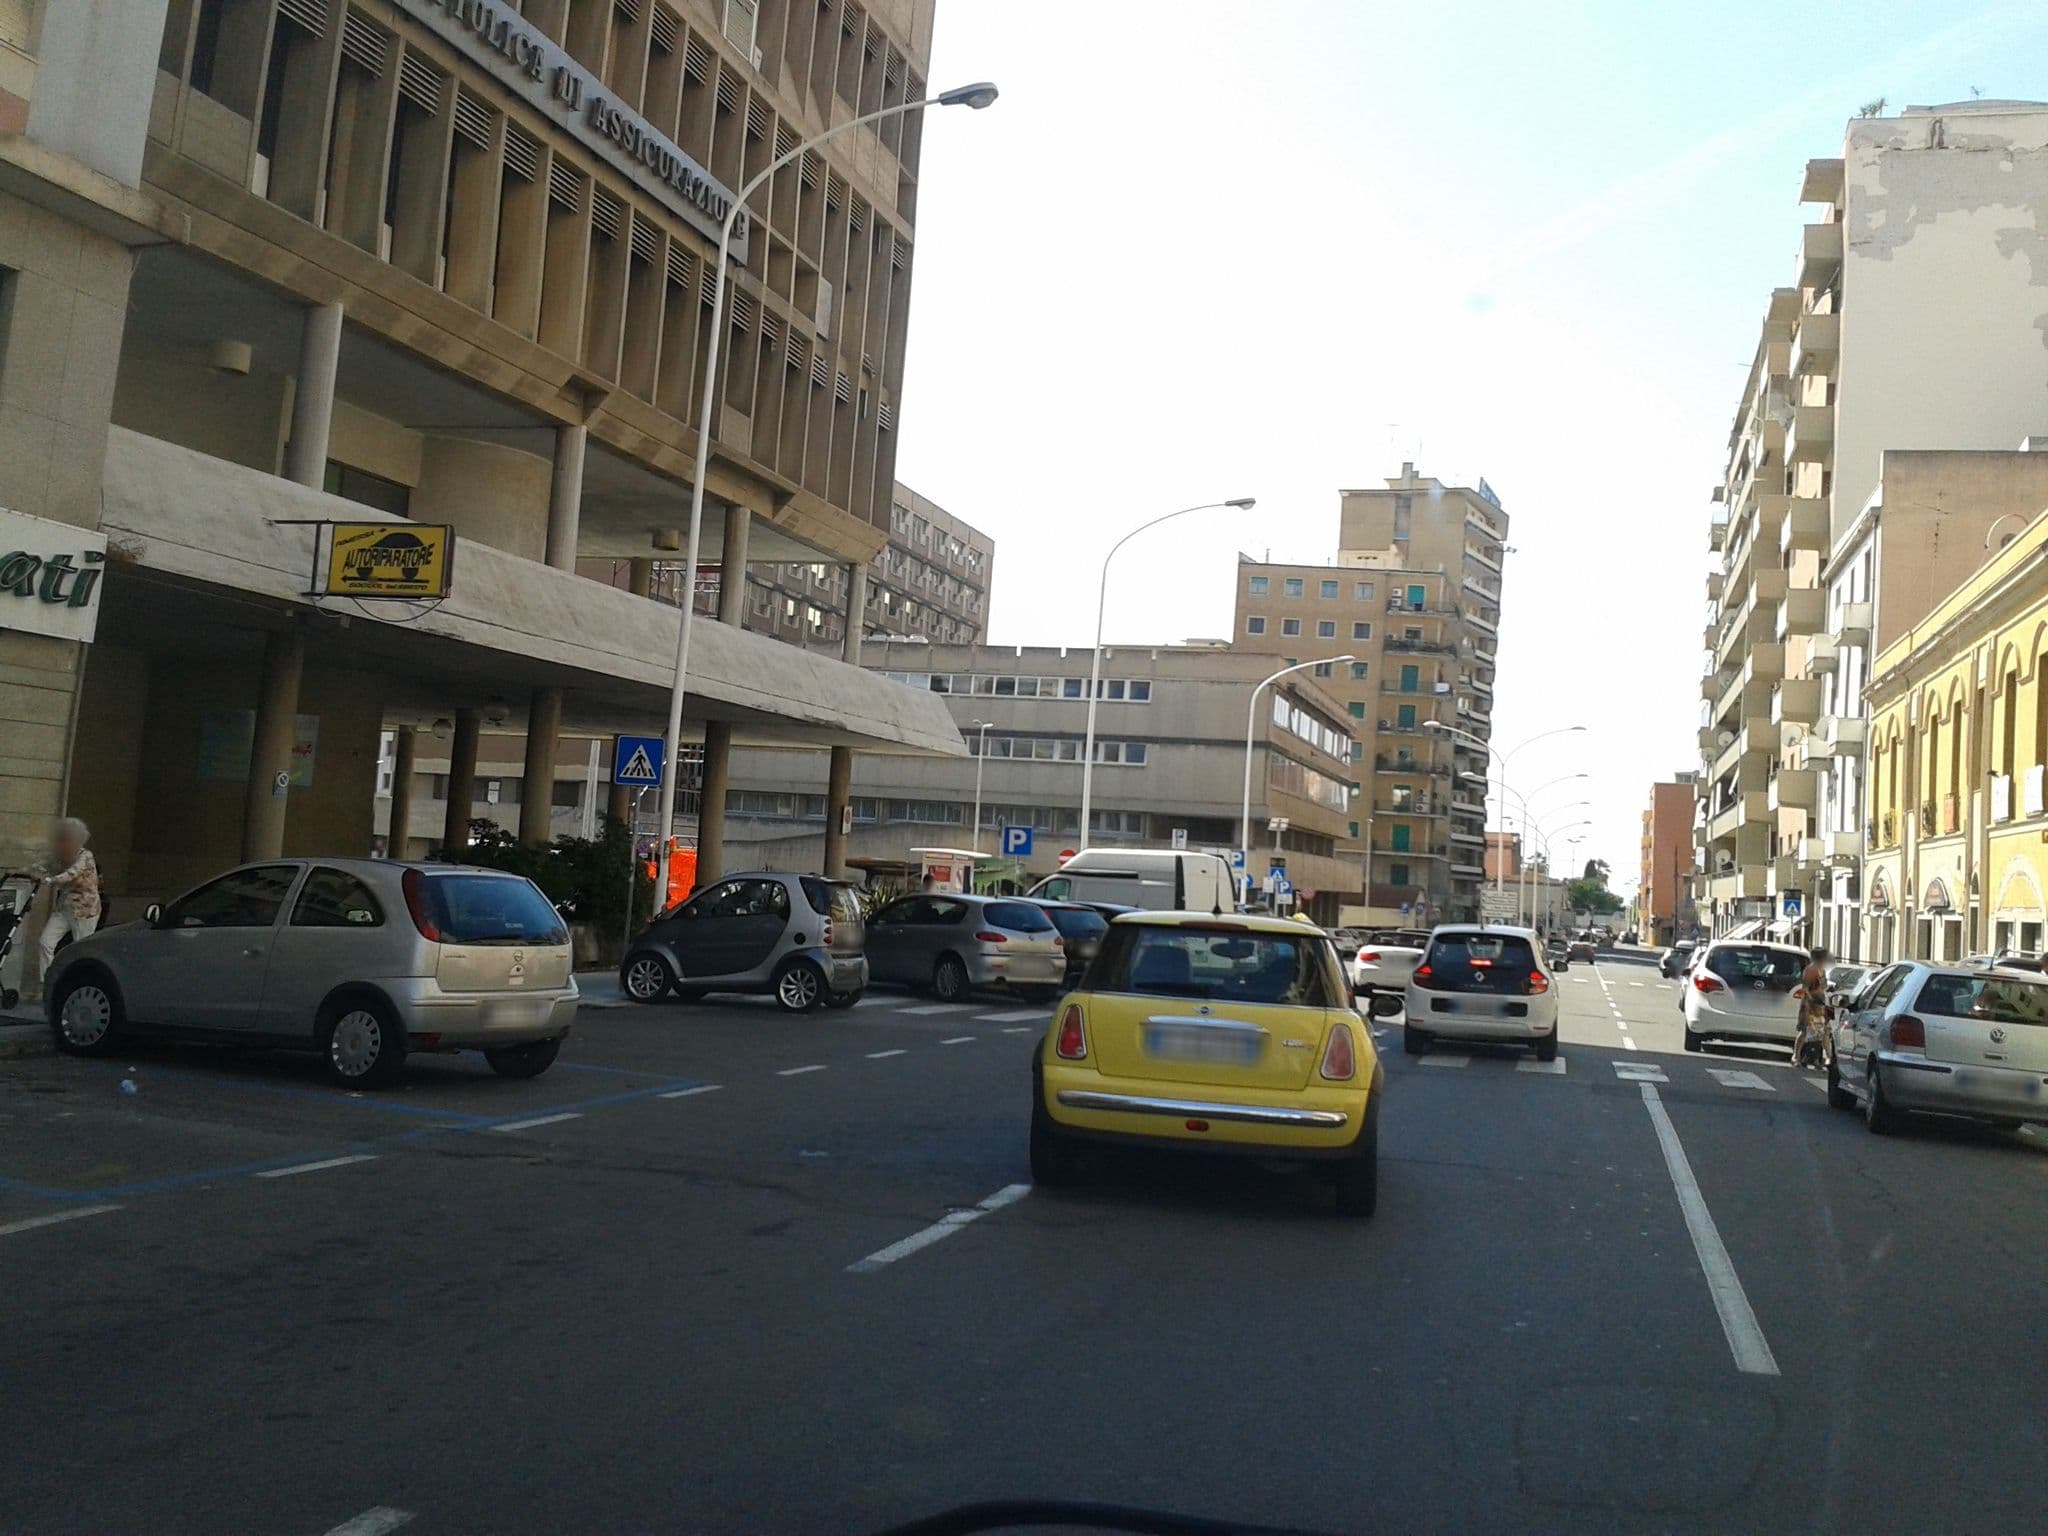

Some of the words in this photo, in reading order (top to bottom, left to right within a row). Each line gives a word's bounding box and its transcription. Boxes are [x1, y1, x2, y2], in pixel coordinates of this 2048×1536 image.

[557, 65, 583, 112] DI
[342, 542, 436, 572] AUTORIPARATORE
[1008, 828, 1027, 853] P
[1231, 852, 1242, 866] P
[1280, 881, 1290, 893] P
